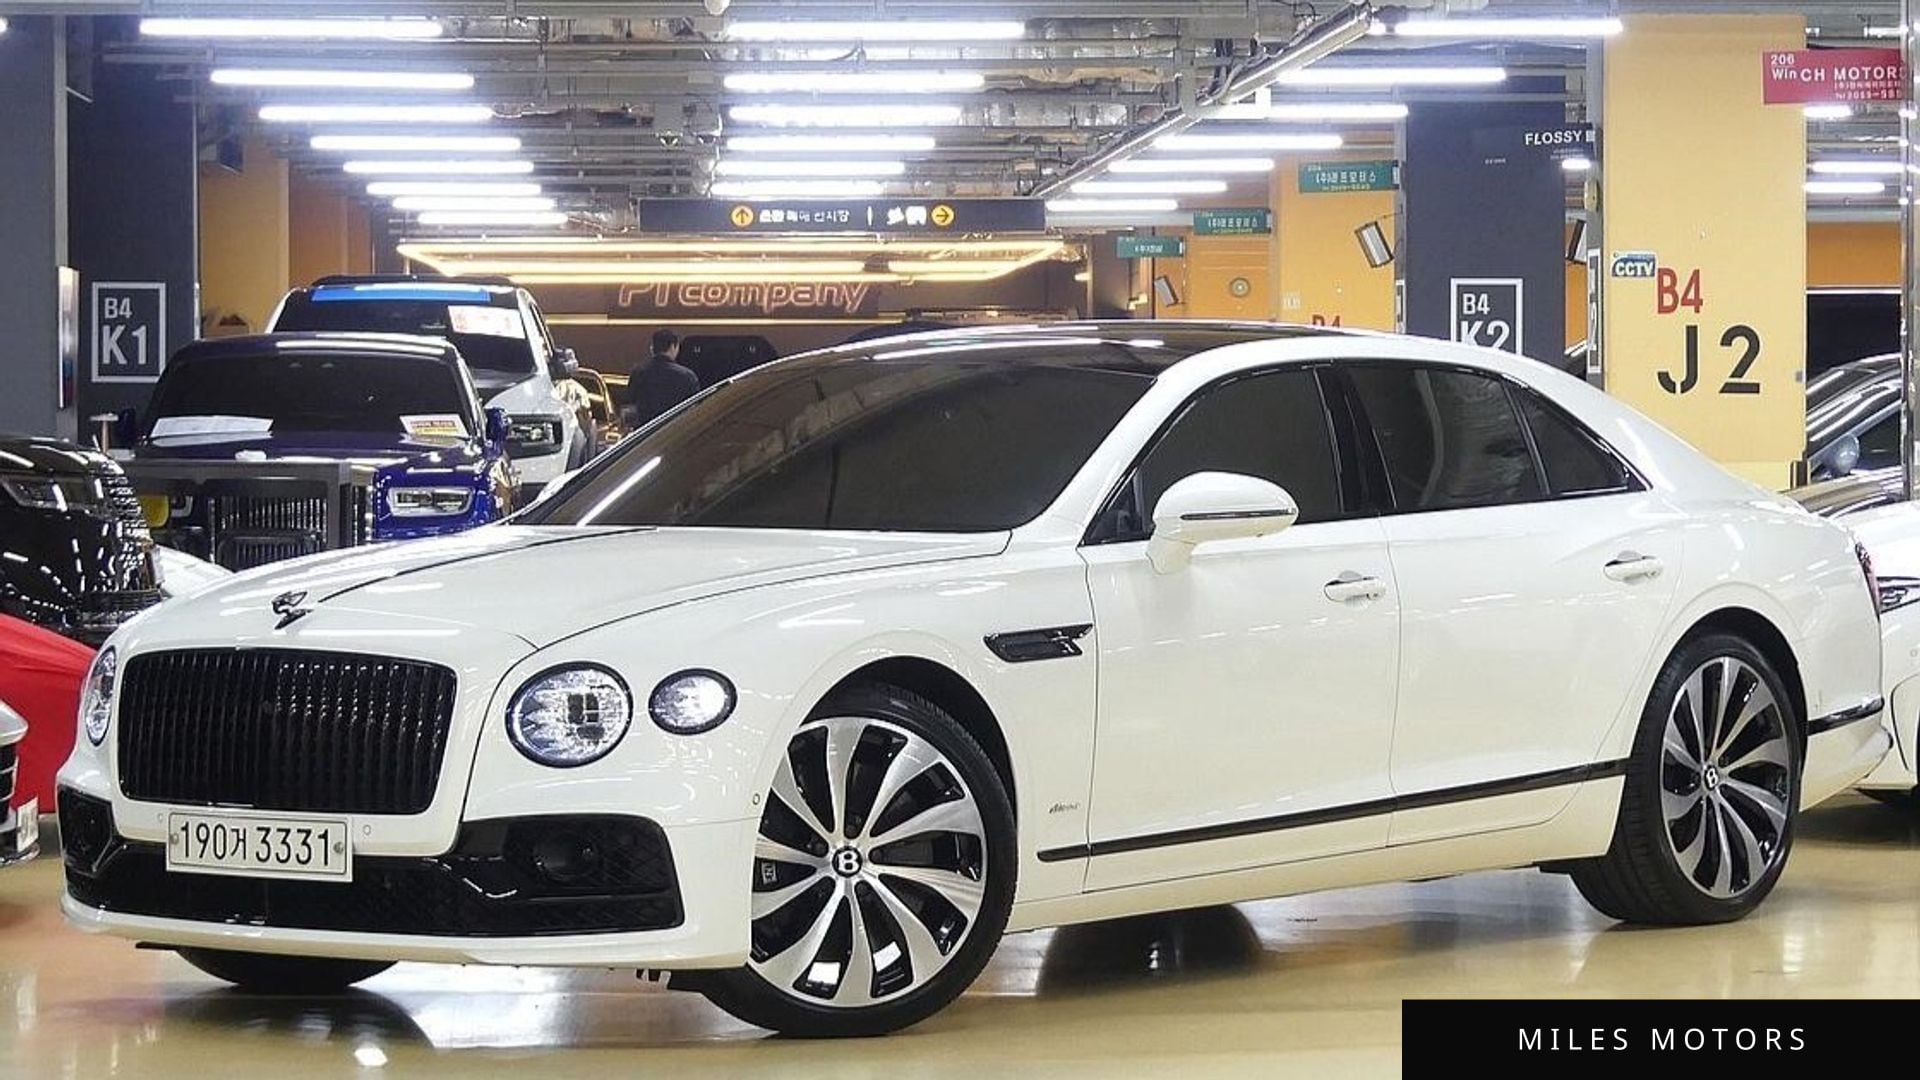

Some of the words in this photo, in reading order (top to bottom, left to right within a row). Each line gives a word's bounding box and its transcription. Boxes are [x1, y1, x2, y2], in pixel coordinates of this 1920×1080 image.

[1525, 130, 1582, 145] FLOSSY
[1615, 262, 1654, 276] CCTV
[678, 281, 869, 314] company
[1462, 293, 1490, 315] B4
[1657, 267, 1704, 314] B4
[104, 297, 133, 319] B4
[102, 325, 147, 365] K1
[1460, 320, 1510, 349] K2
[180, 821, 247, 861] 190거
[255, 826, 329, 867] 3331
